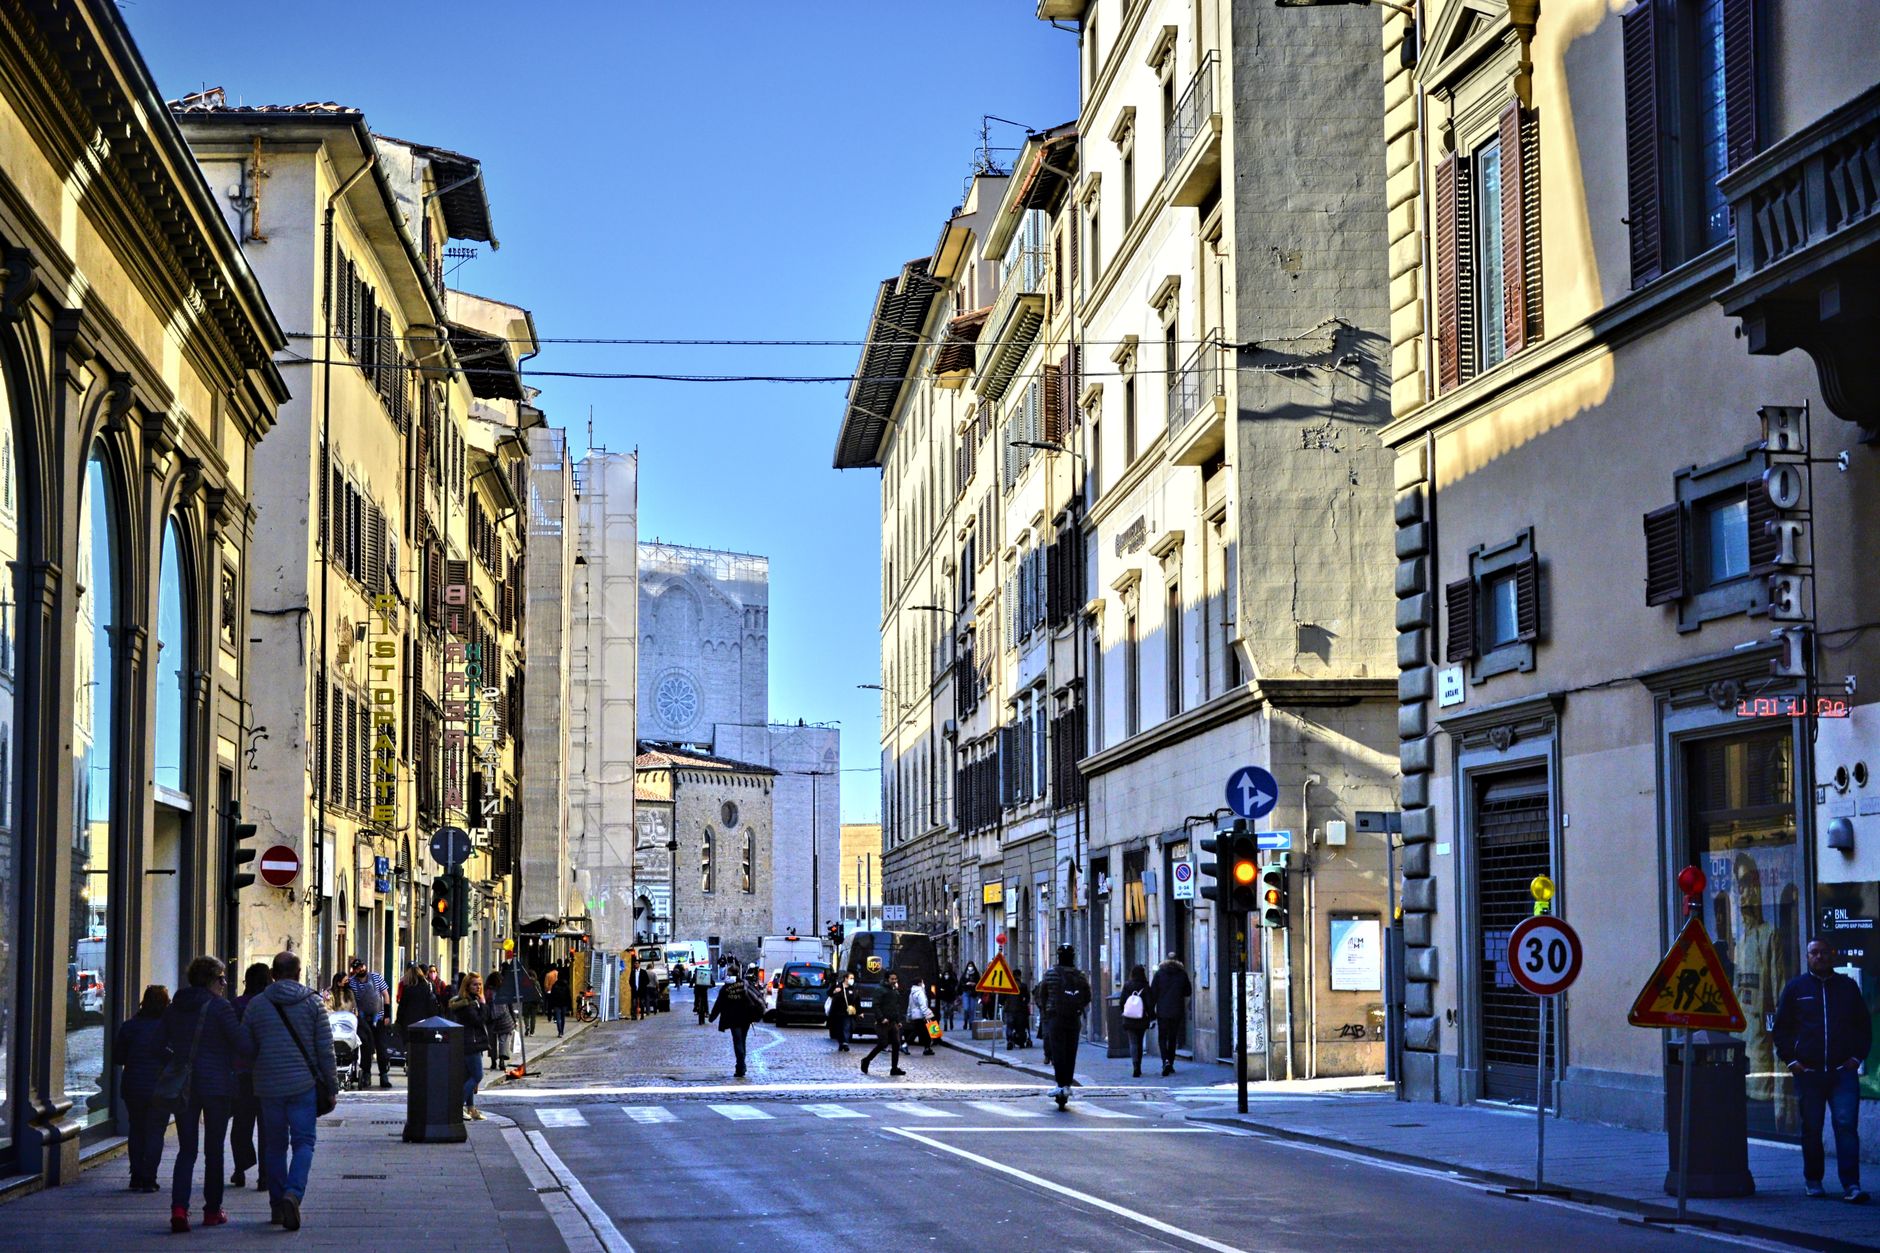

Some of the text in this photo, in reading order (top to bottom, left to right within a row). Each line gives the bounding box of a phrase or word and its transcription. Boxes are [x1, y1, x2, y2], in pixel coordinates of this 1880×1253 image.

[373, 594, 396, 822] RISTORANTE
[1834, 908, 1849, 920] BNL
[867, 961, 881, 971] ups
[1525, 937, 1567, 973] 30
